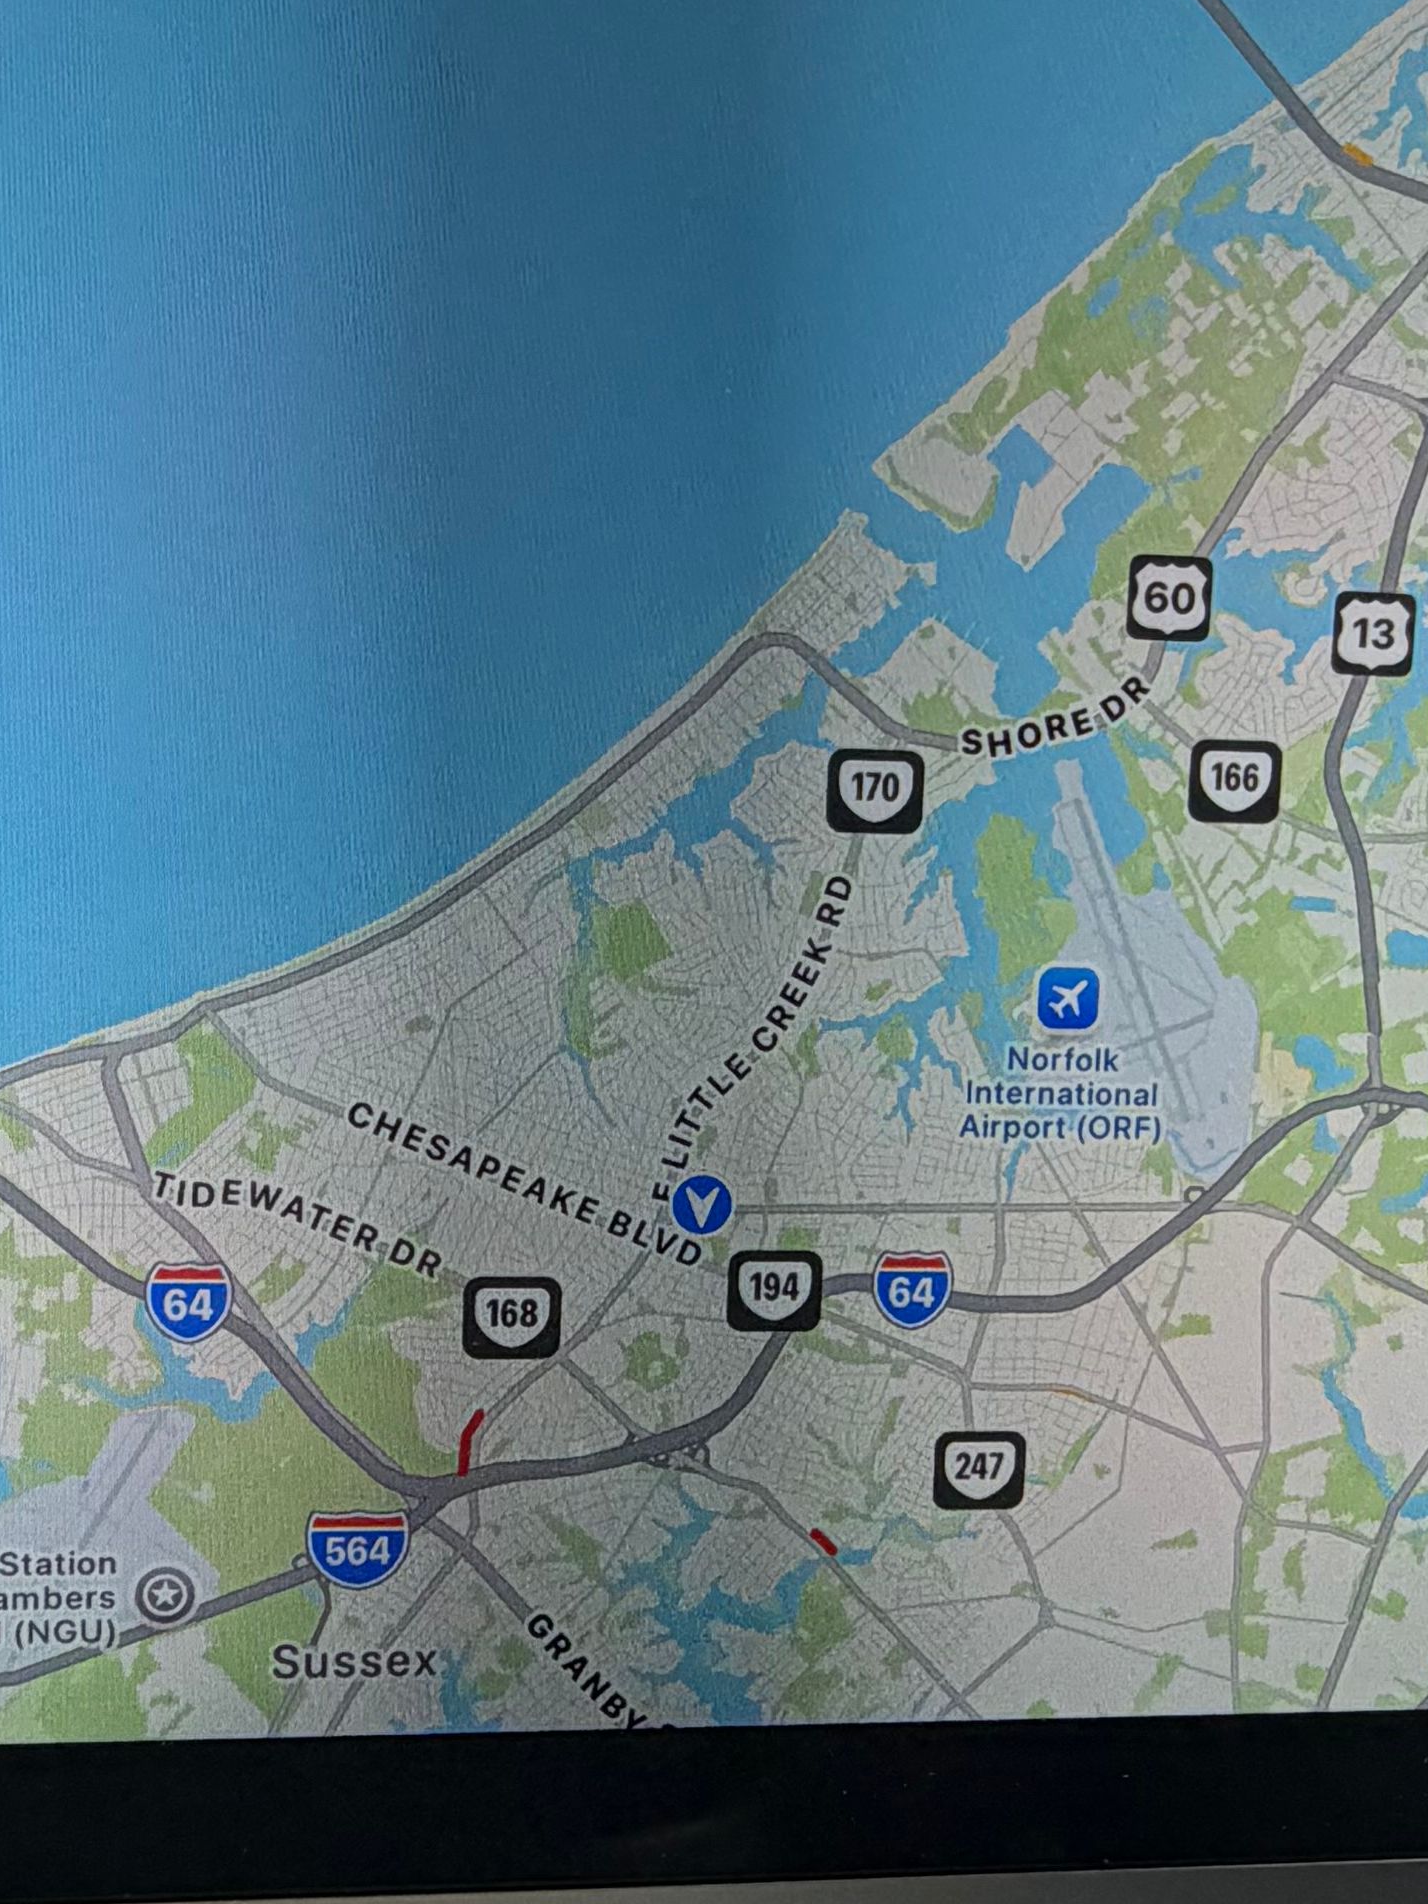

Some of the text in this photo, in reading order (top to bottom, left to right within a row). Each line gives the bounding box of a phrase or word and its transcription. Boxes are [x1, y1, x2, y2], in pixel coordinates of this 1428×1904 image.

[1144, 583, 1196, 614] 60
[1352, 617, 1397, 653] 13
[961, 676, 1152, 759] SHORE DR
[851, 772, 900, 803] 170
[1211, 762, 1259, 793] 166
[661, 1052, 752, 1170] LITTLE
[755, 938, 833, 1054] CREEK
[816, 874, 853, 931] RD
[1008, 1046, 1119, 1074] Norfolk
[966, 1082, 1158, 1109] International
[959, 1112, 1162, 1145] Airport (ORF)
[346, 1101, 705, 1269] CHESAPEAKE BLVD
[153, 1171, 443, 1280] TIDEWATER DR
[749, 1272, 800, 1302] 194
[888, 1276, 934, 1309] 64
[163, 1288, 214, 1324] 64
[485, 1298, 540, 1330] 168
[954, 1451, 1003, 1481] 247
[324, 1535, 393, 1568] 564
[15, 1618, 116, 1650] (NGU)
[272, 1644, 438, 1680] Sussex
[528, 1614, 648, 1730] GRANBY
